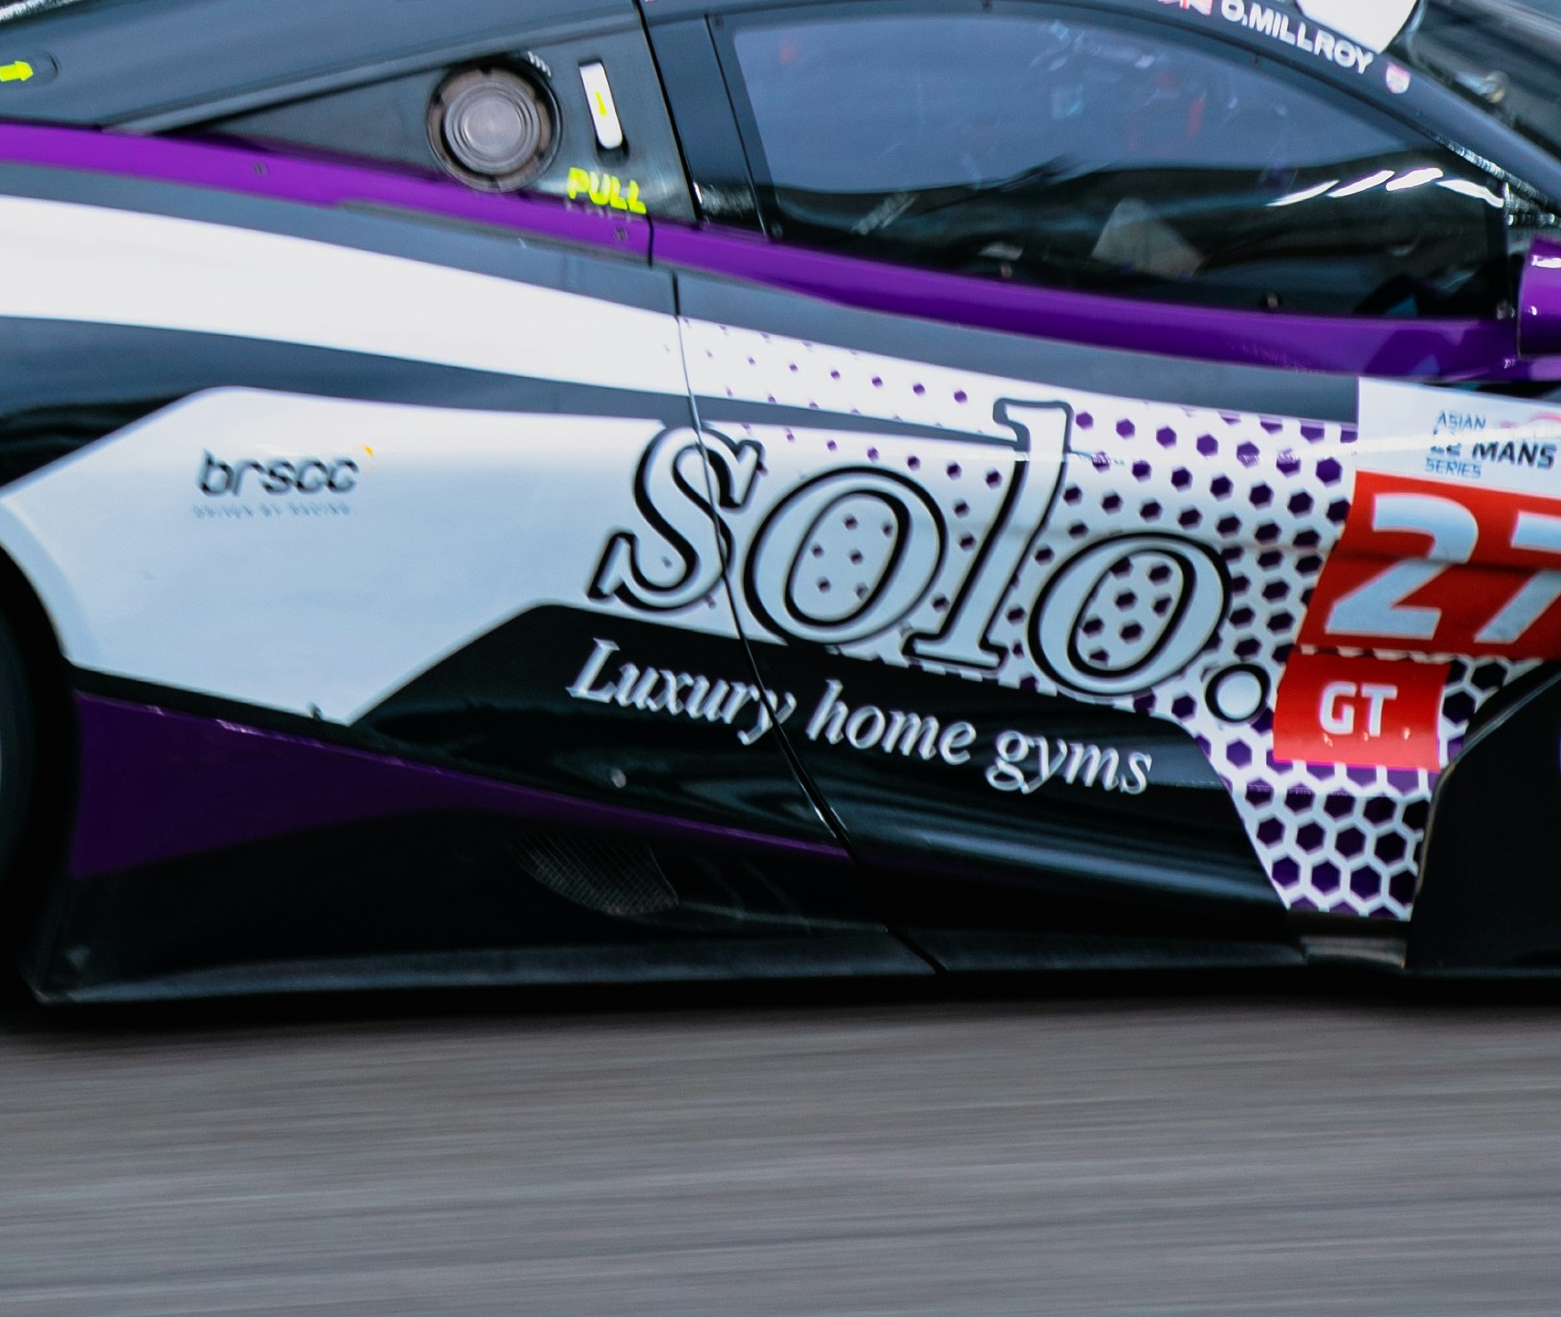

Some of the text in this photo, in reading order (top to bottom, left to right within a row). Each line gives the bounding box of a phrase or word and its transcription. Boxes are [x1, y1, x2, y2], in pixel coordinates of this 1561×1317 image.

[567, 167, 647, 215] PULL
[1435, 410, 1488, 431] ASIAN
[1424, 457, 1482, 479] SERIES
[1471, 439, 1558, 470] MANS
[565, 637, 1156, 797] Luxury home gyms
[1318, 681, 1398, 737] GT
